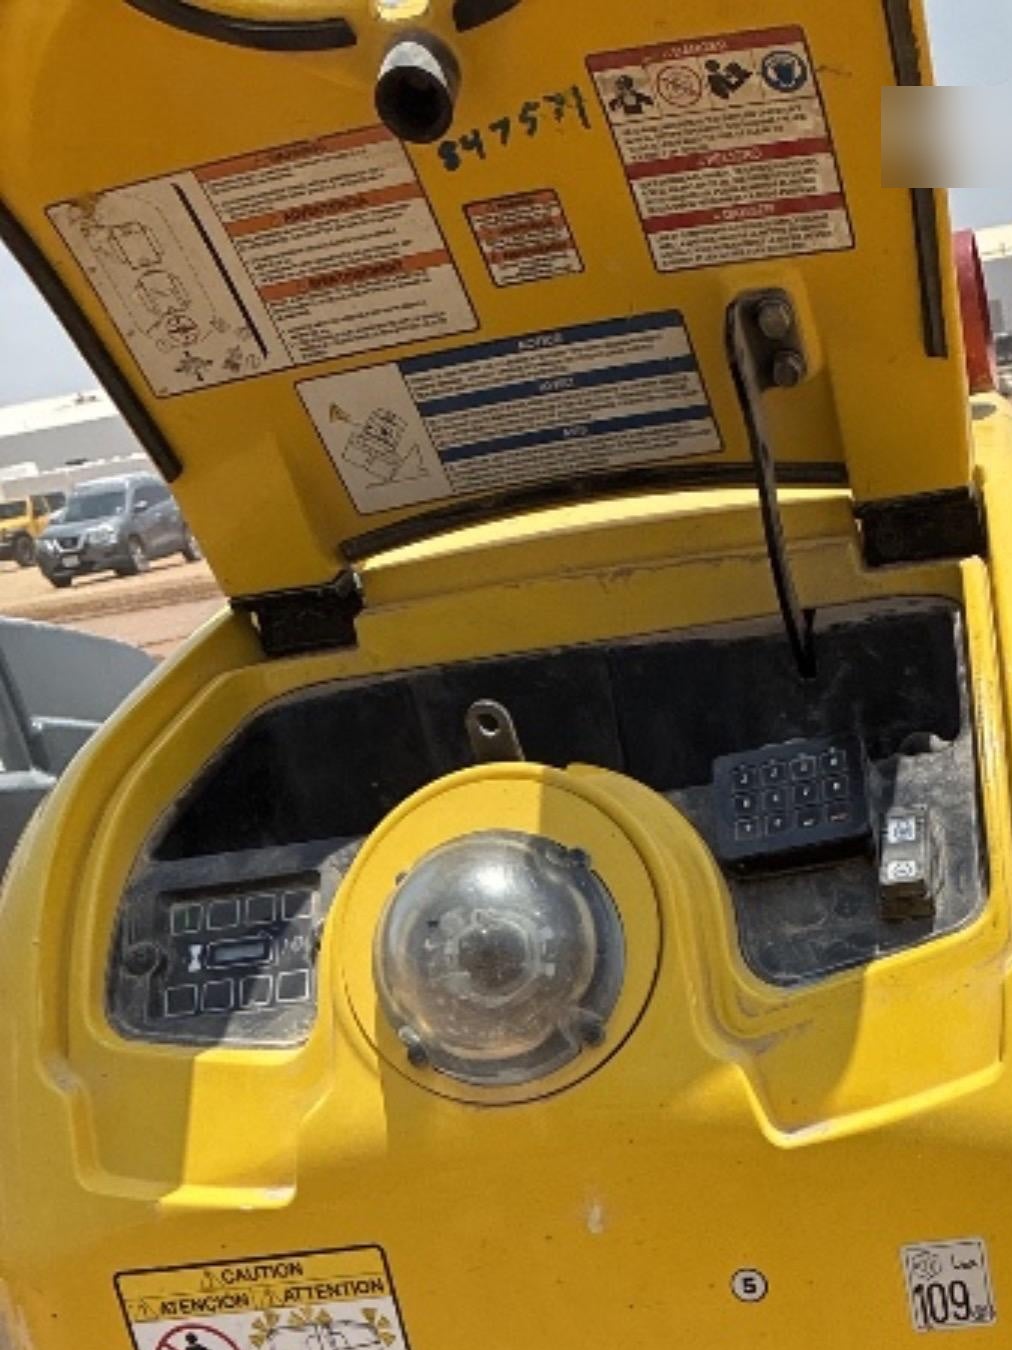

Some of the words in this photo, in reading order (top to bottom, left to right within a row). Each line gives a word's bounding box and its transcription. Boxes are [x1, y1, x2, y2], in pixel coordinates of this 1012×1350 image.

[220, 1261, 304, 1284] CAUTION
[283, 1278, 384, 1301] ATTENTION
[743, 1277, 757, 1294] 5
[913, 1280, 970, 1324] 109
